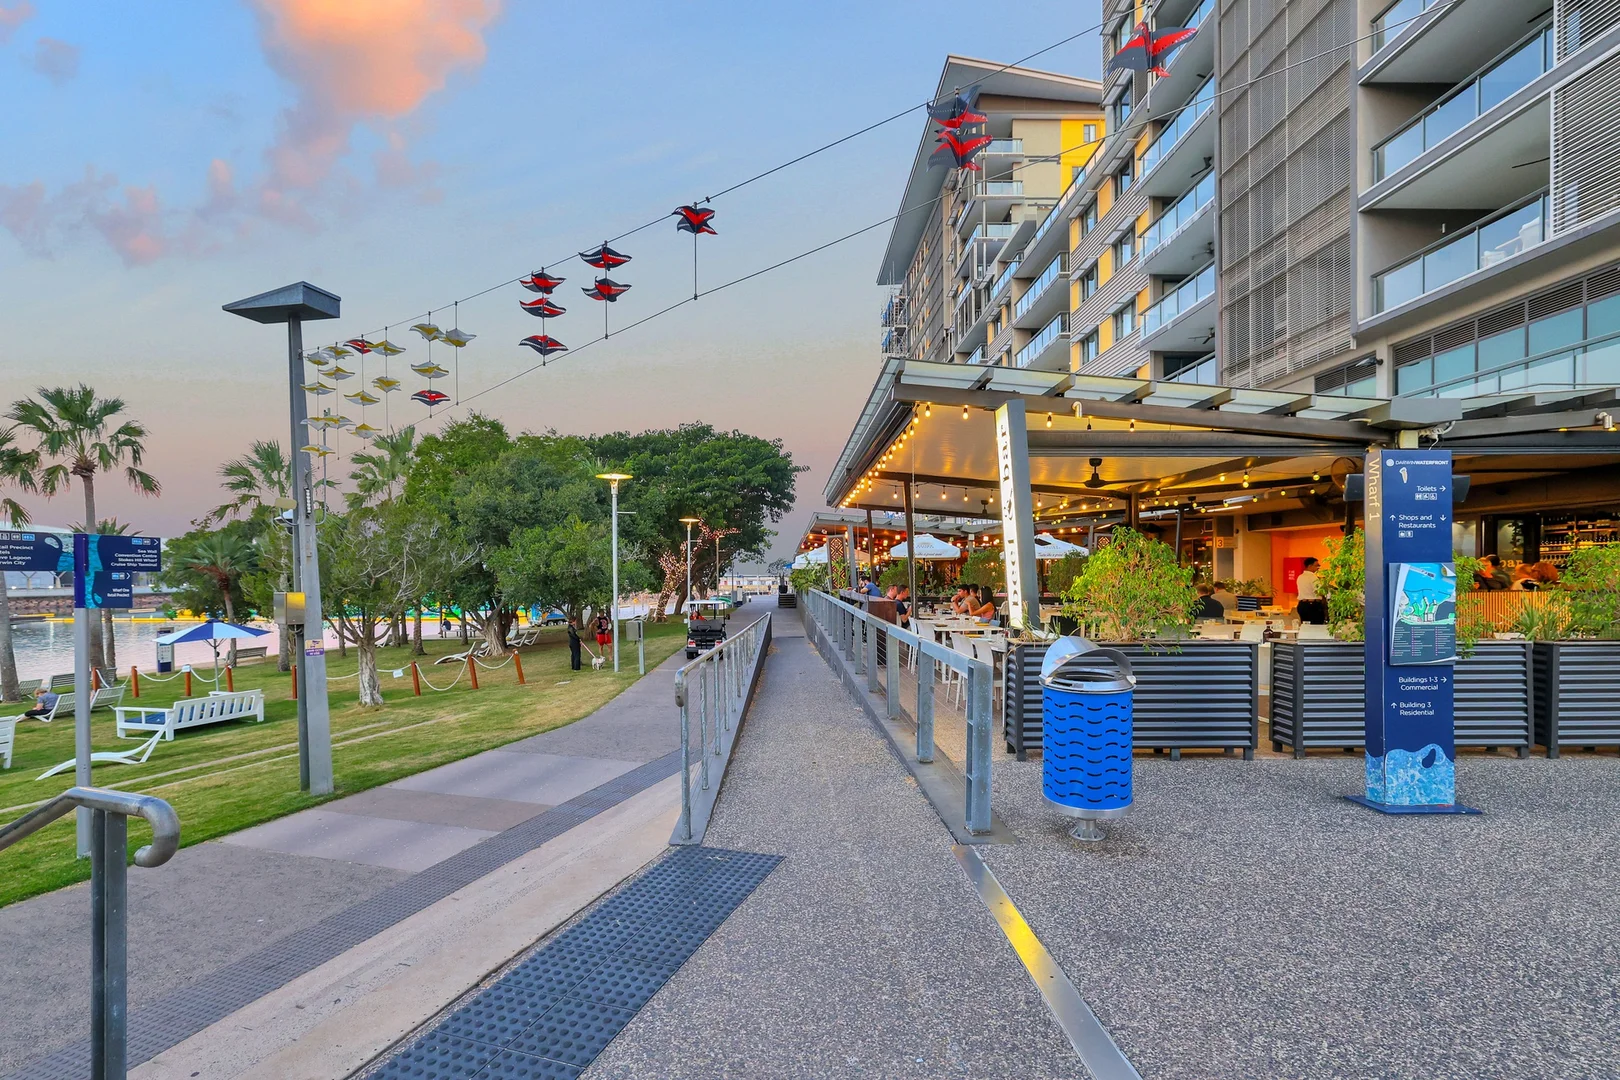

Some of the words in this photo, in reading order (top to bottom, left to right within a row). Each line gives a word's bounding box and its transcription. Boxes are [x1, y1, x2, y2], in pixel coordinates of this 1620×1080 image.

[1368, 458, 1380, 507] Wharf
[1369, 512, 1380, 521] 1
[1398, 676, 1428, 684] Buildings
